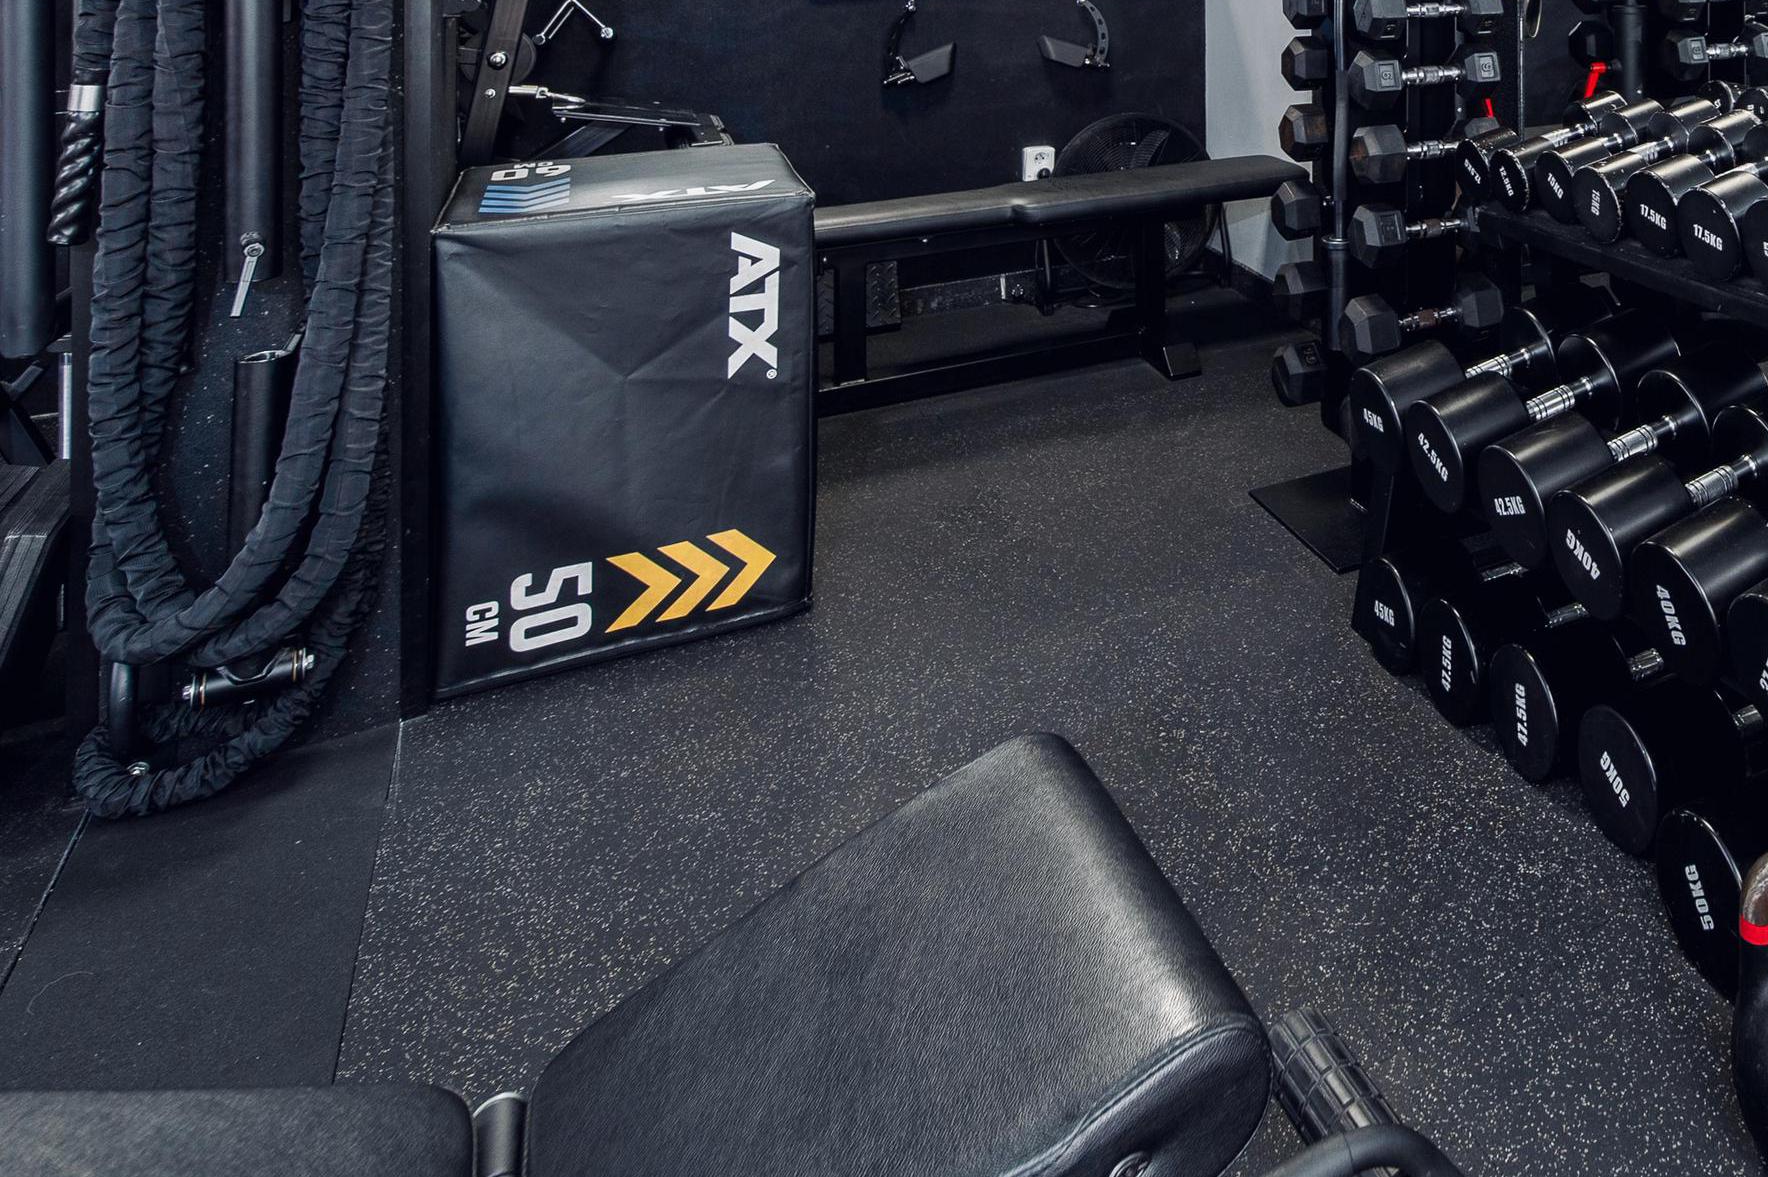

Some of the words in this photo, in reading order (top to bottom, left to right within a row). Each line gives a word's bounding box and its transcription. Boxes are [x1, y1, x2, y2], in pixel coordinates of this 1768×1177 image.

[1546, 172, 1564, 199] 15KG
[1591, 189, 1601, 216] 15KG
[1640, 203, 1667, 230] 17.5KG
[1693, 223, 1723, 251] 17.5KG
[1363, 407, 1385, 433] 45KG
[1418, 432, 1449, 482] 42.5KG
[1494, 495, 1526, 516] 42.5KG
[1566, 529, 1601, 580] 40KG
[465, 600, 499, 647] CM
[510, 561, 593, 653] 50
[1374, 600, 1396, 626] 45KG
[1656, 584, 1687, 646] 40KG
[1441, 635, 1453, 692] 47.5KG
[1515, 683, 1528, 746] 47.5KG
[1600, 750, 1630, 808] 50KG
[1684, 864, 1714, 932] 50KG
